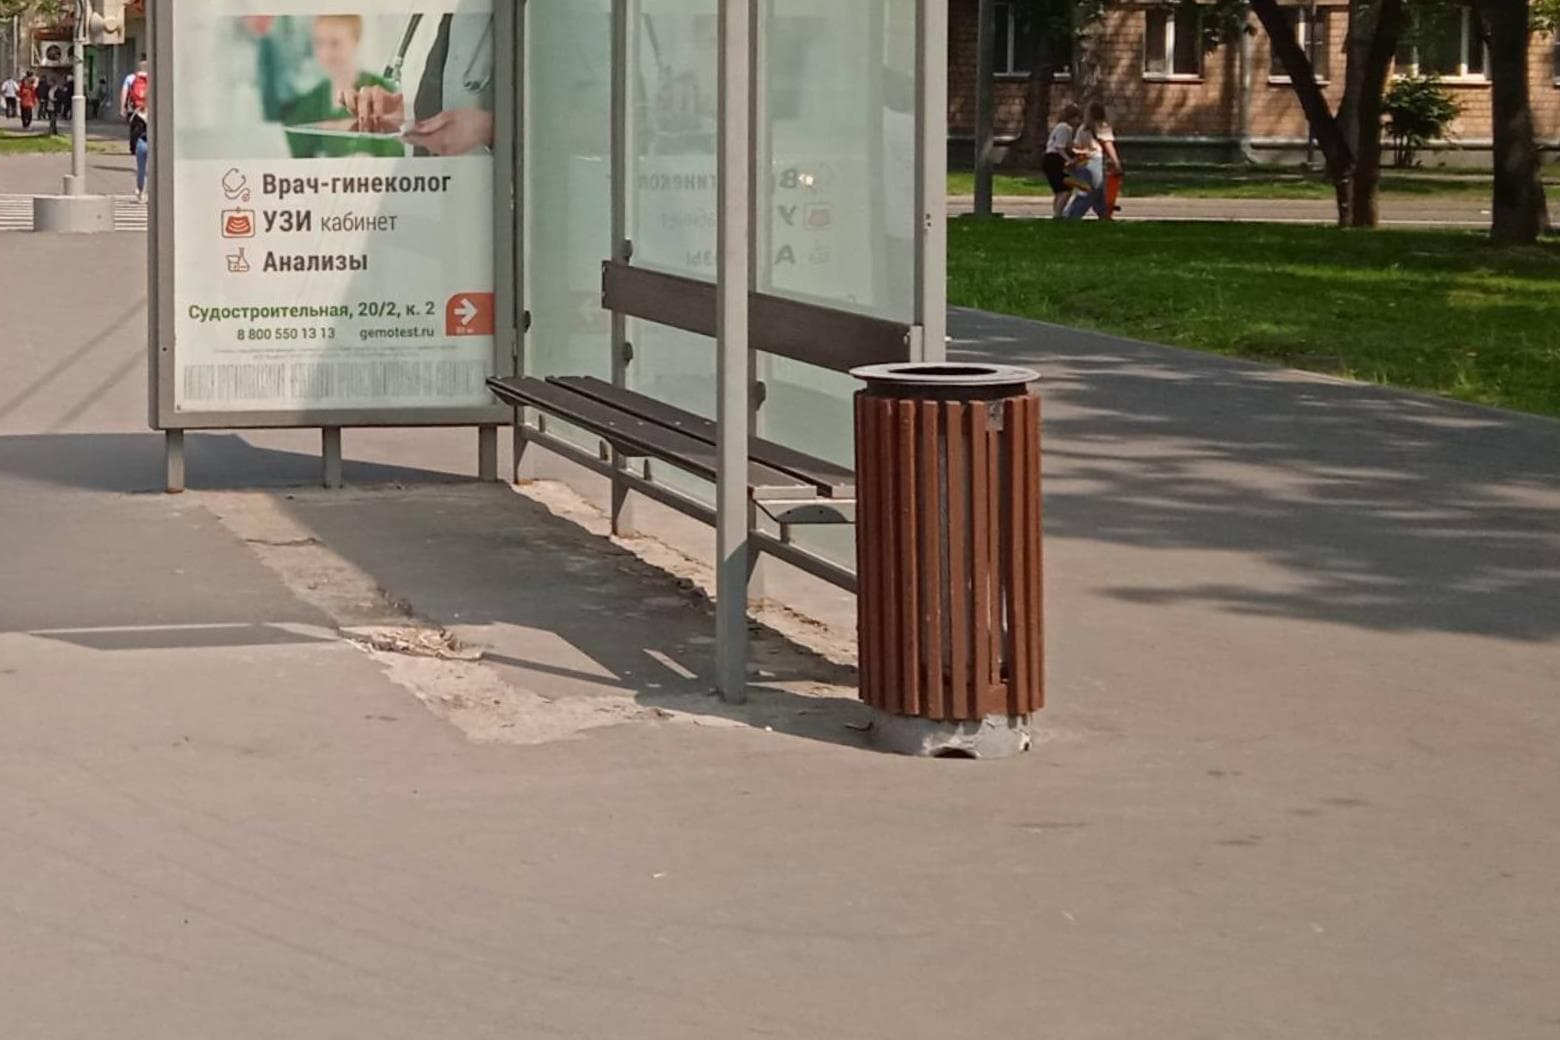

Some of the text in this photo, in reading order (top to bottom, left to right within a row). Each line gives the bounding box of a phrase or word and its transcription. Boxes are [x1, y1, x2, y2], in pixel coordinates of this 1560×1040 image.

[262, 173, 452, 199] Врач-гинеколог
[263, 210, 398, 232] УЗИ кабинет
[263, 253, 368, 272] Анализы
[188, 304, 354, 323] Судостроительная,
[358, 302, 401, 318] 20/2,
[425, 301, 436, 315] 2
[237, 327, 336, 341] 8 800 550 13 13
[359, 326, 435, 340] gemotest.ru
